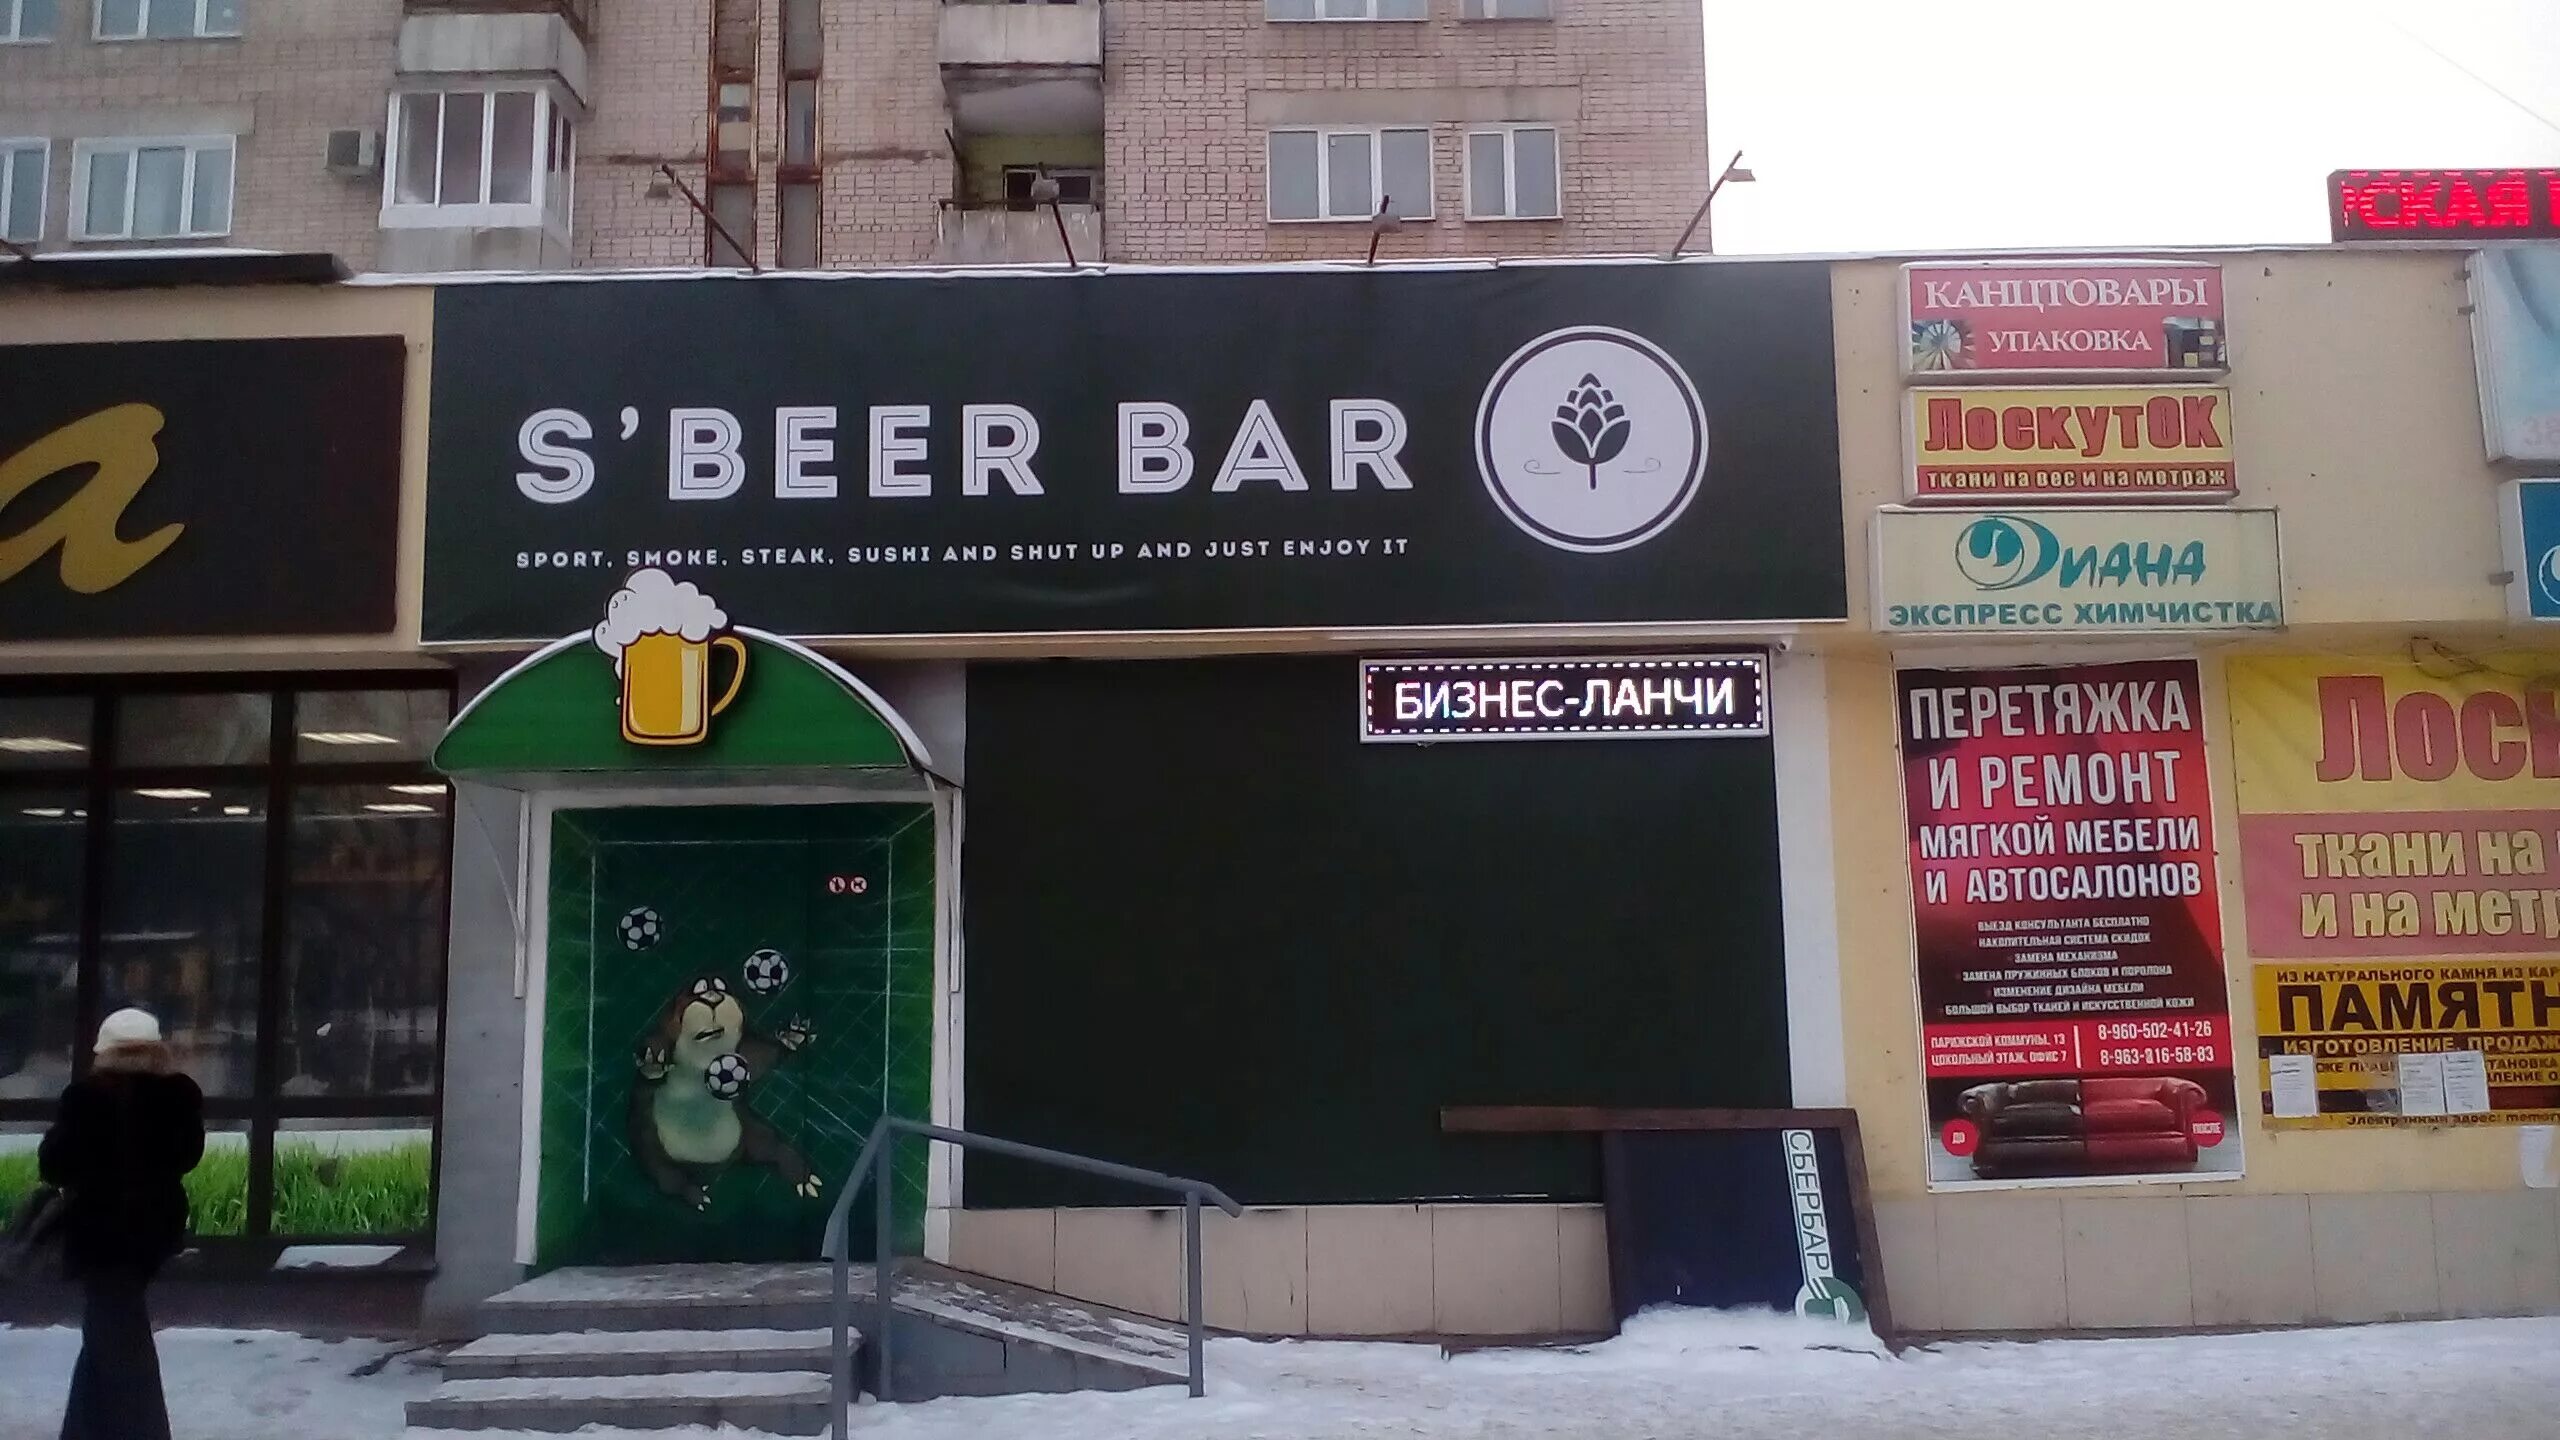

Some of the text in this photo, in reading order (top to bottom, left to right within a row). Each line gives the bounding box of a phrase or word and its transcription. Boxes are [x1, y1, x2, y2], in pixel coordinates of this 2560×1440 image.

[1924, 277, 2209, 313] КАНЦТОВАРЫ
[1987, 329, 2152, 353] УПАКОВКА
[1117, 397, 1414, 494] BAR
[1927, 468, 2228, 489] ткани на вес и на метраж
[847, 546, 931, 563] SUSHI
[942, 544, 997, 562] AND
[1010, 543, 1078, 560] SHUT
[1091, 543, 1125, 560] UP
[1137, 542, 1192, 559] AND
[1205, 540, 1270, 558] JUST
[1284, 538, 1371, 557] ENJOY
[1383, 537, 1409, 555] IT
[1888, 601, 2279, 627] ЭКСПРЕСС ХИМЧИСТКА
[1395, 676, 1736, 719] БИЗНЕС-ЛАНЧИ
[1909, 680, 2191, 740] ПЕРЕТЯЖКА
[1929, 750, 2181, 810] И РЕМОНТ
[1919, 814, 2201, 860] МЯГКОЙ МЕБЕЛИ
[2293, 831, 2467, 879] ткани
[2475, 829, 2547, 876] на
[1925, 862, 2202, 904] И АВТОСАЛОНОВ
[1978, 916, 2150, 932] ВЫЕЗД КОНСУЛЬТАНТА БЕСПЛАТНО
[2300, 892, 2339, 939] и
[2350, 890, 2421, 938] на
[1978, 932, 2151, 948] НАКОПИТЕЛЬНАЯ СИСТЕМА СКИДОК
[2014, 950, 2119, 964] ЗАМЕНА МЕХАНИЗМА
[1962, 971, 2003, 982] ЗАМЕНА
[2004, 968, 2069, 981] ПРУЖИННЫХ
[2070, 966, 2110, 979] БЛОКОВ
[2121, 965, 2173, 977] ПОРОЛОНА
[2277, 971, 2298, 982] ИЗ
[2303, 969, 2435, 983] НАТУРАЛЬНОГО
[2440, 967, 2496, 980] КАМНЯ
[2502, 967, 2523, 979] ИЗ
[1993, 982, 2144, 997] ИЗМЕНЕНИЕ ДИЗАЙНА МЕБЕЛИ
[1945, 1003, 1994, 1015] БОЛЬШОЙ
[1996, 1002, 2030, 1014] ВЫБОР
[2032, 999, 2071, 1013] ТКАНЕЙ
[2165, 997, 2195, 1008] КОЖИ
[1930, 1033, 1993, 1048] ПАРИЖСКОЙ
[2053, 1033, 2066, 1045] 13
[2098, 1020, 2212, 1041] 8-960-502-41-26
[1931, 1050, 1995, 1067] ЦОКОЛЬНЫЙ
[2060, 1050, 2067, 1062] 7
[2486, 1057, 2558, 1070] ТАНОВКА
[2487, 1071, 2544, 1082] ЛЕНИЕ
[1789, 1131, 1830, 1271] СБЕРБАР
